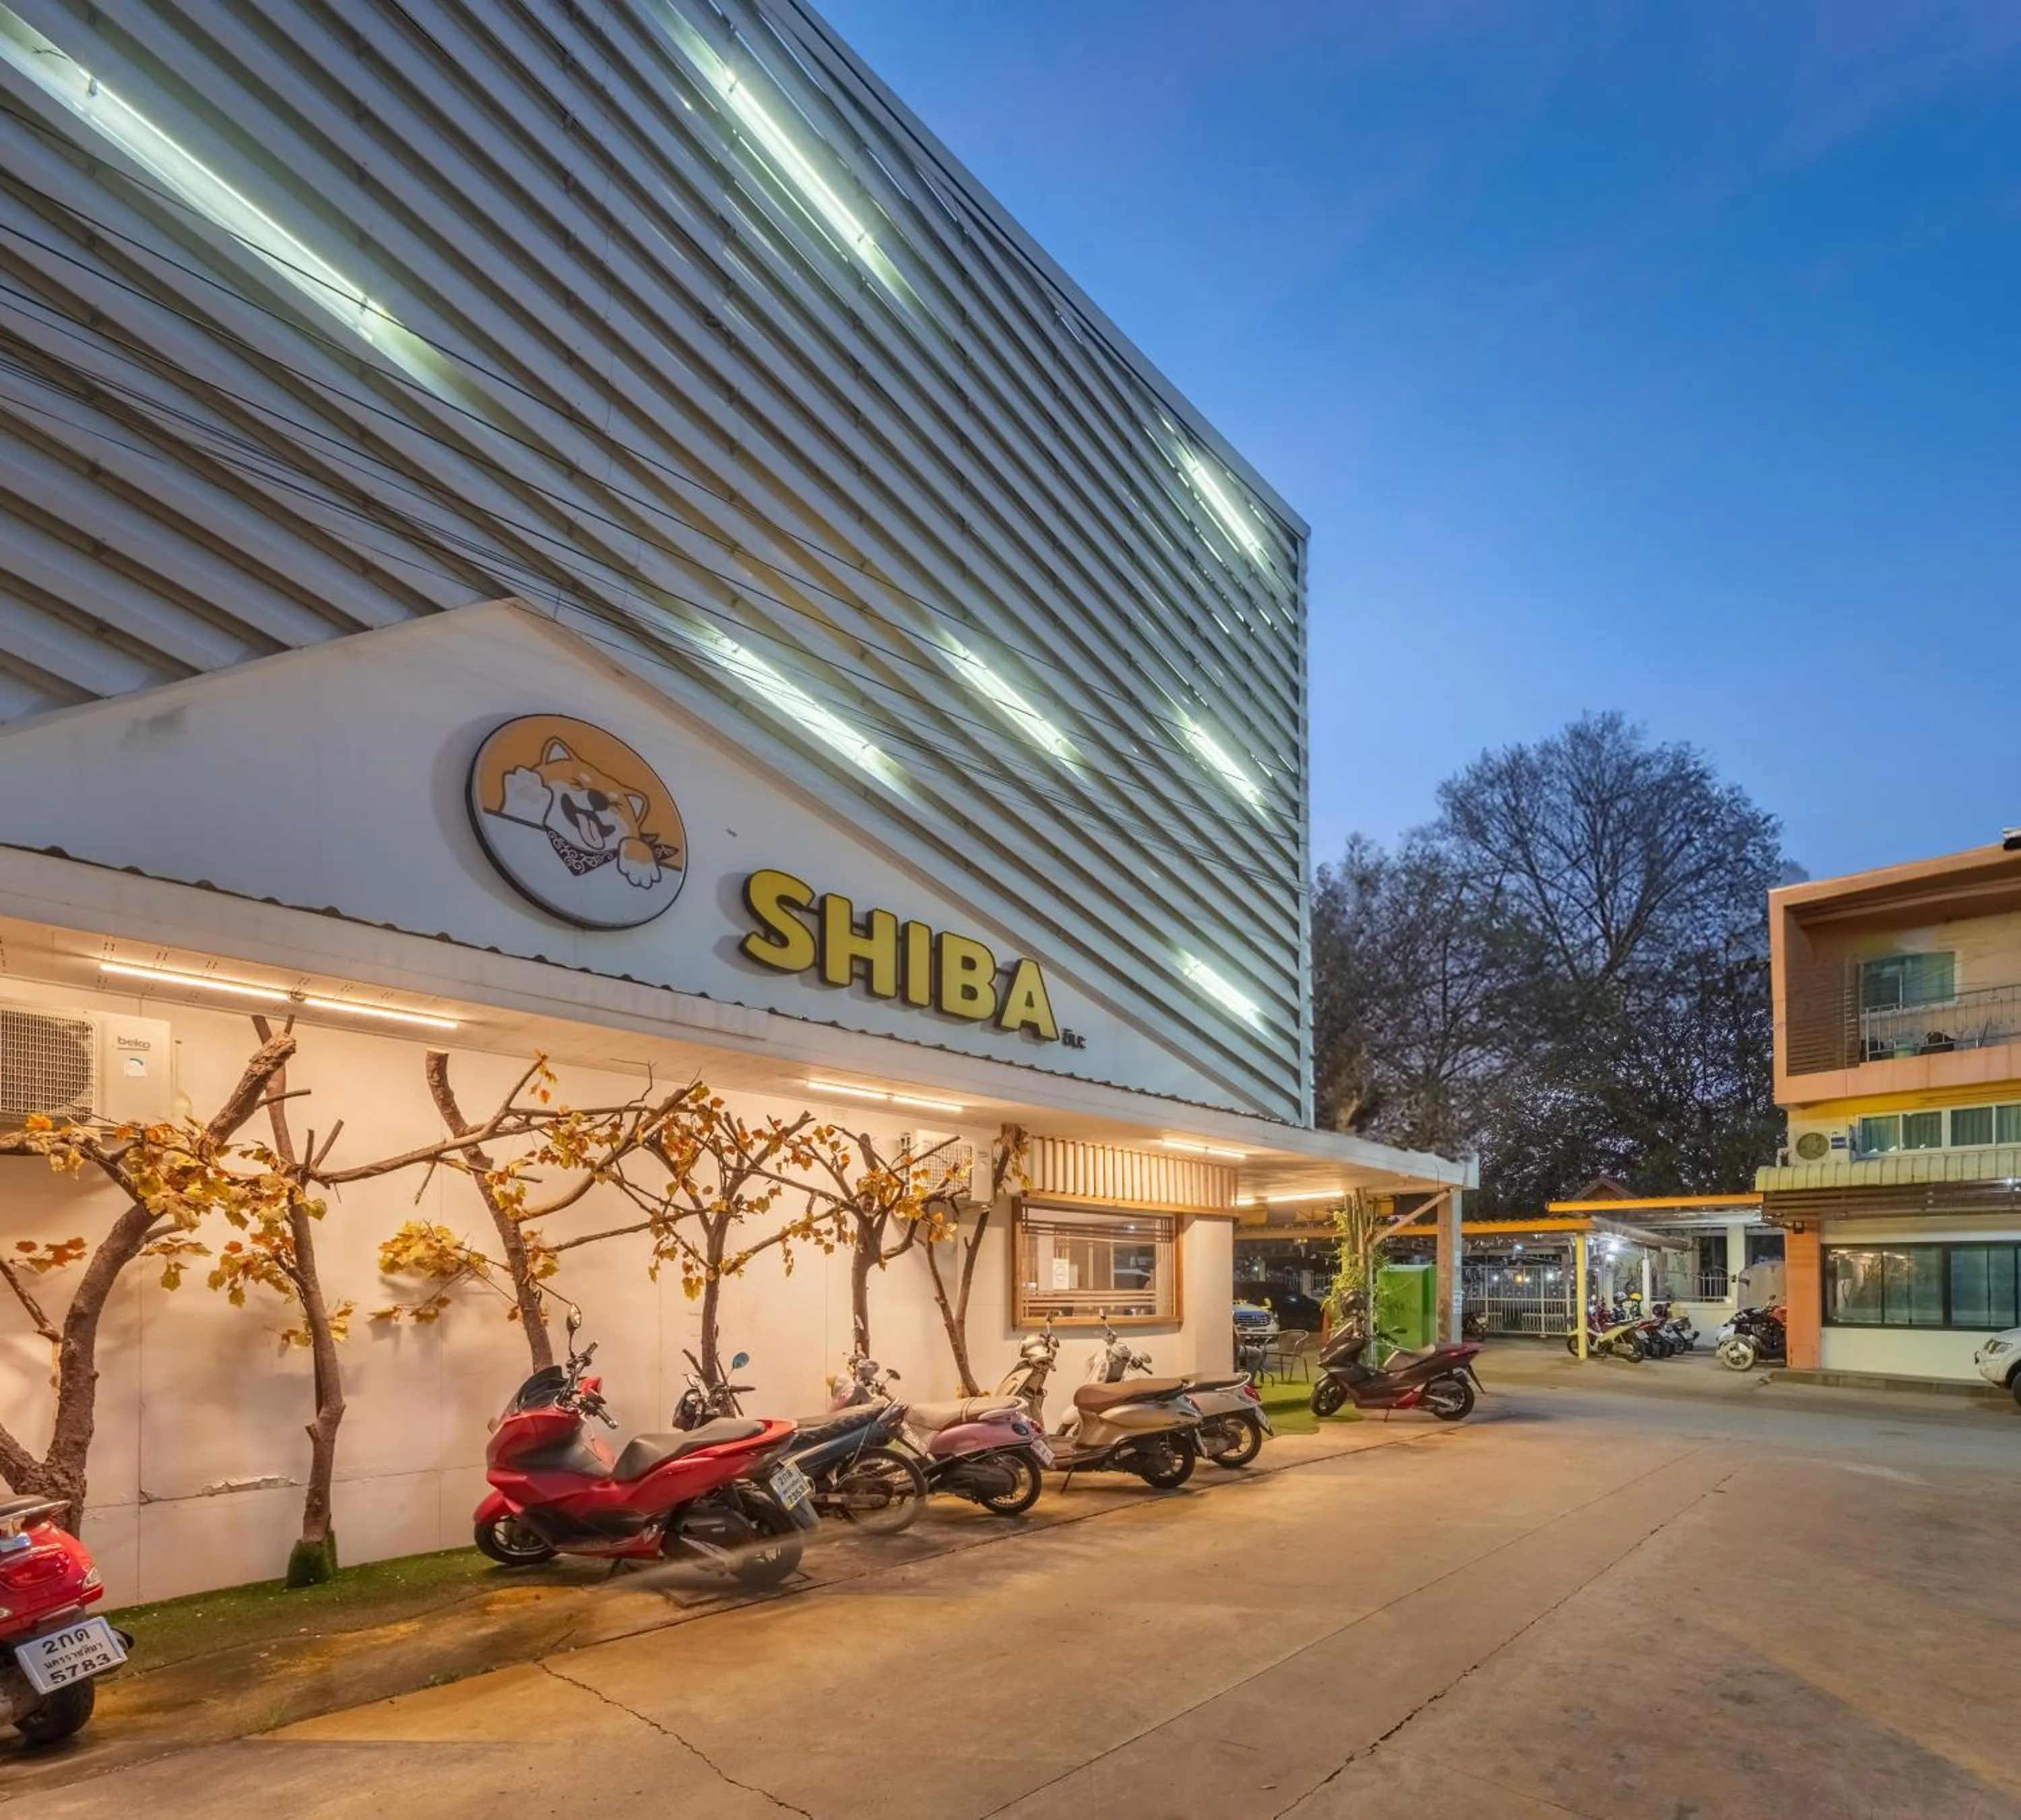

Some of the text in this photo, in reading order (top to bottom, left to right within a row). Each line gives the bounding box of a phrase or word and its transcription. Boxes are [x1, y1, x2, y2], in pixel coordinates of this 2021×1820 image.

[741, 868, 1060, 1042] SHIBA
[43, 1642, 104, 1670] นครราชสีมา
[49, 1653, 111, 1684] 5783
